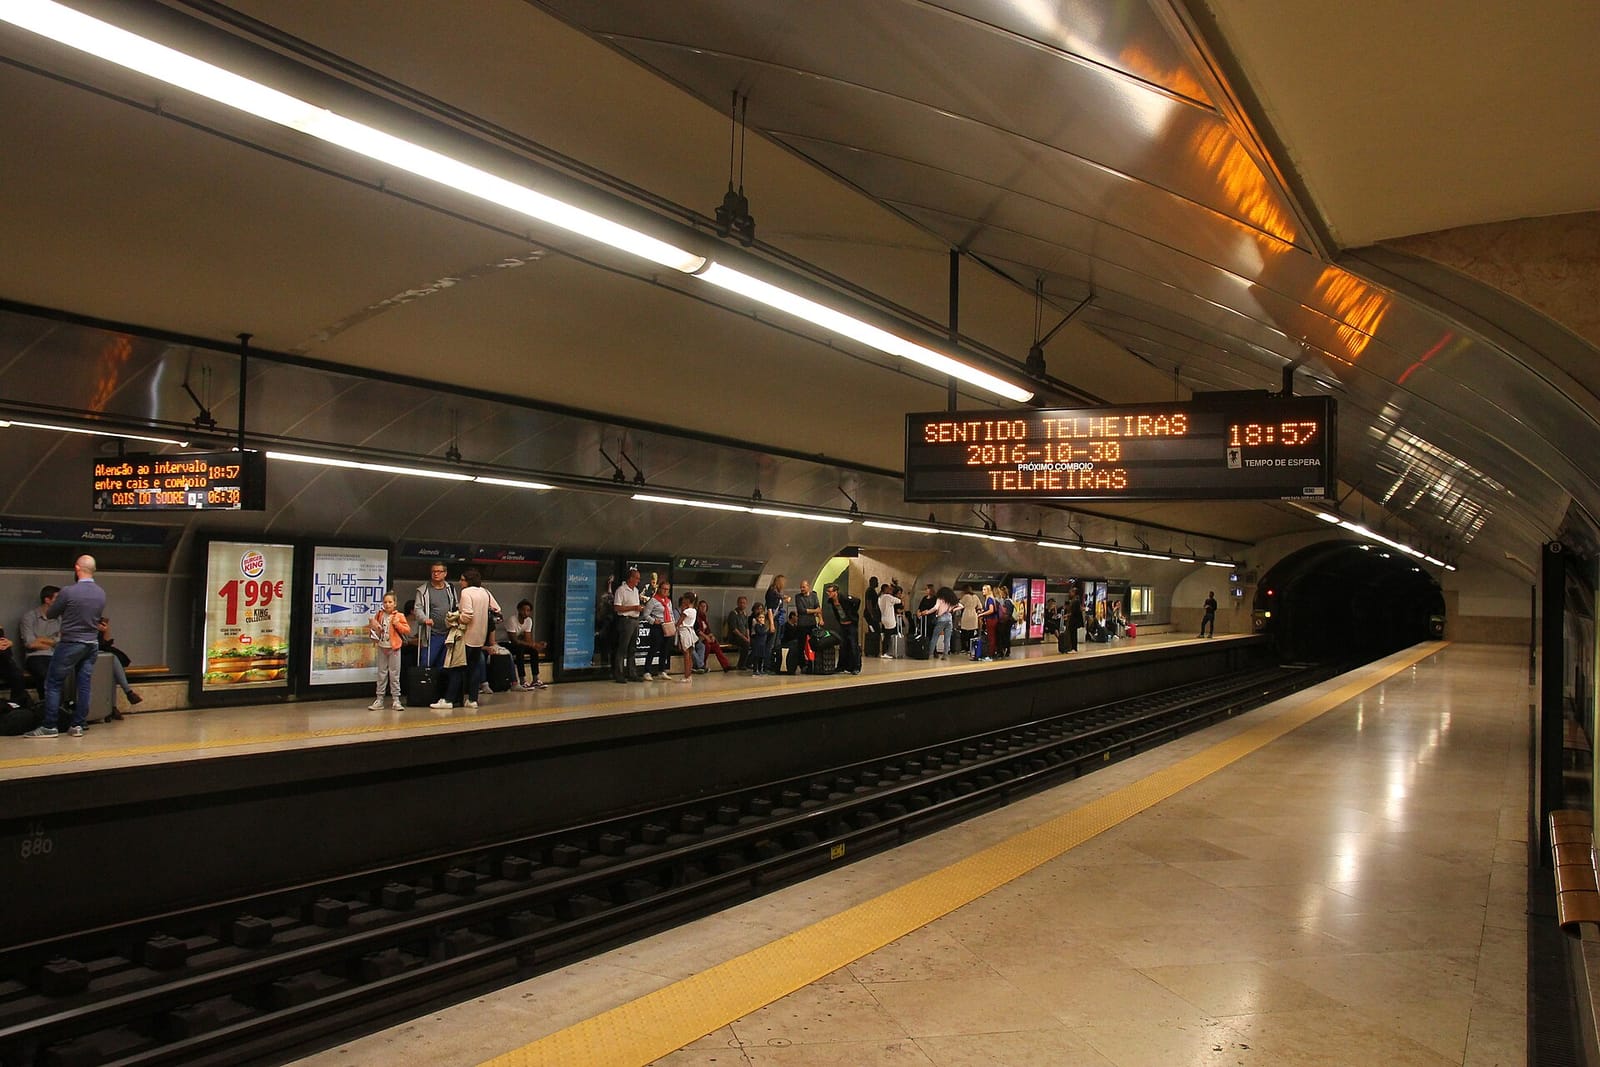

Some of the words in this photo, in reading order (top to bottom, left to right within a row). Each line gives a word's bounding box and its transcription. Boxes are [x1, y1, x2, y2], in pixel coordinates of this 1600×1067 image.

[925, 420, 1026, 443] SENTIDO
[1042, 414, 1187, 439] TELHEIRAS
[1229, 422, 1317, 447] 18:57
[967, 441, 1120, 464] 2016-10-30
[137, 465, 150, 475] ao
[154, 460, 207, 474] intervalo
[1018, 462, 1054, 471] PRÓXIMO
[1054, 462, 1094, 471] COMBOIO
[1245, 459, 1273, 467] TEMPO
[1287, 458, 1321, 466] ESPERA
[208, 465, 240, 480] 18:57
[988, 468, 1128, 490] TELHEIRAS
[94, 478, 123, 490] entre
[126, 477, 149, 489] cais
[153, 478, 161, 488] e
[164, 475, 207, 488] comboio
[112, 491, 135, 505] CAIS
[139, 491, 151, 505] DO
[207, 490, 240, 504] 06:30
[82, 531, 116, 540] Alameda
[243, 555, 263, 565] BURGER
[244, 560, 264, 572] KING
[253, 608, 269, 617] KING
